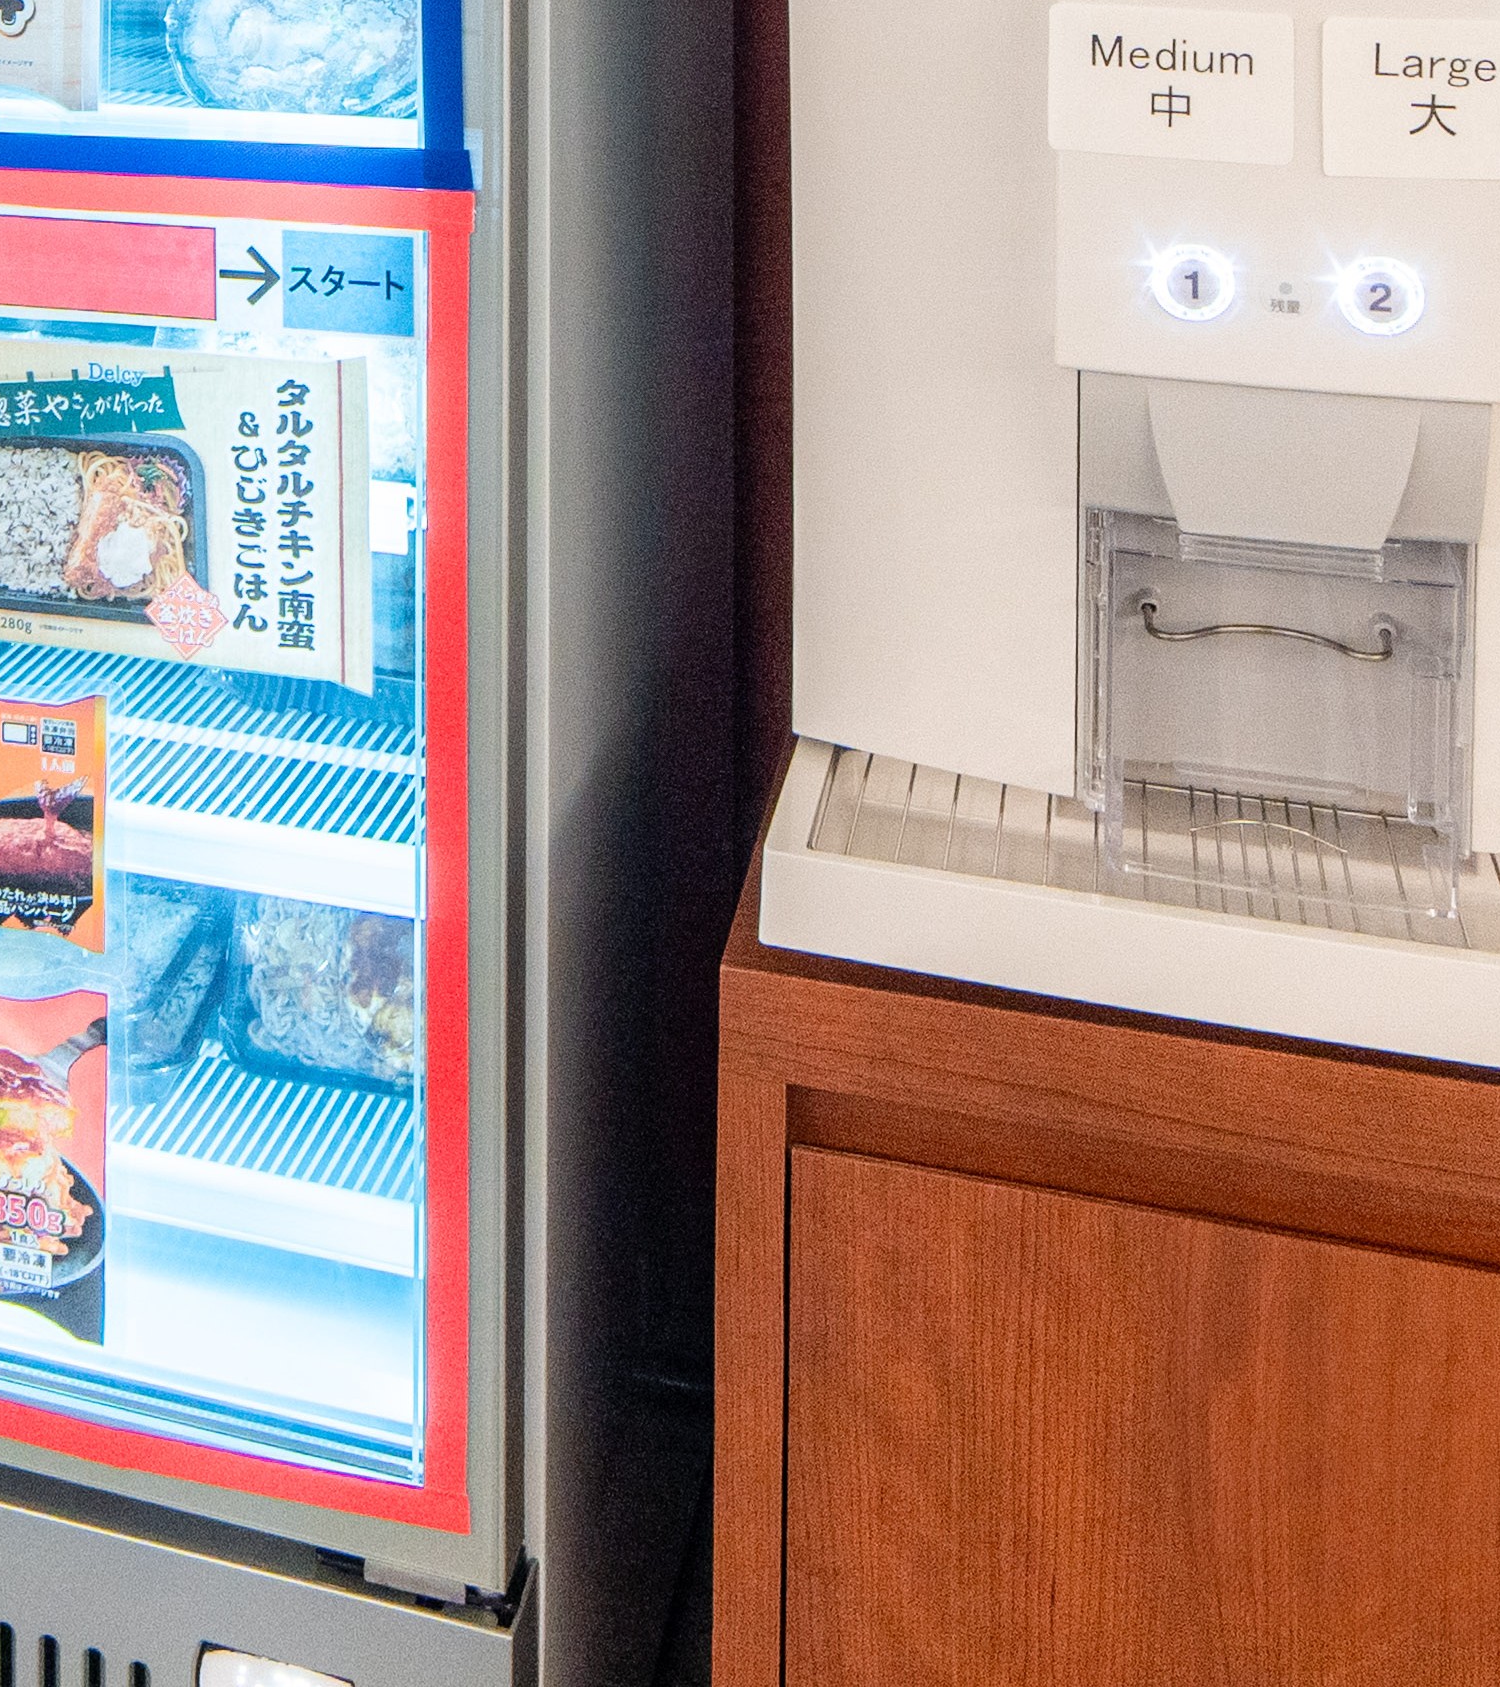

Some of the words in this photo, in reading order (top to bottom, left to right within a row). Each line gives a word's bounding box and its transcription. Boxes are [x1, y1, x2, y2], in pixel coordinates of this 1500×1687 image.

[1091, 34, 1255, 76] Medium
[1374, 42, 1498, 87] Large
[1151, 85, 1191, 128] 中
[1410, 94, 1457, 137] 大
[287, 261, 405, 299] スタート
[1184, 272, 1200, 300] 1
[1369, 283, 1393, 313] 2
[1269, 297, 1301, 315] 残量
[88, 363, 145, 386] Delcy
[232, 411, 269, 633] &ひじきごはん
[277, 378, 315, 652] タルタルチキン南蛮
[1, 617, 33, 635] 280g
[2, 1247, 47, 1267] 要冷凍
